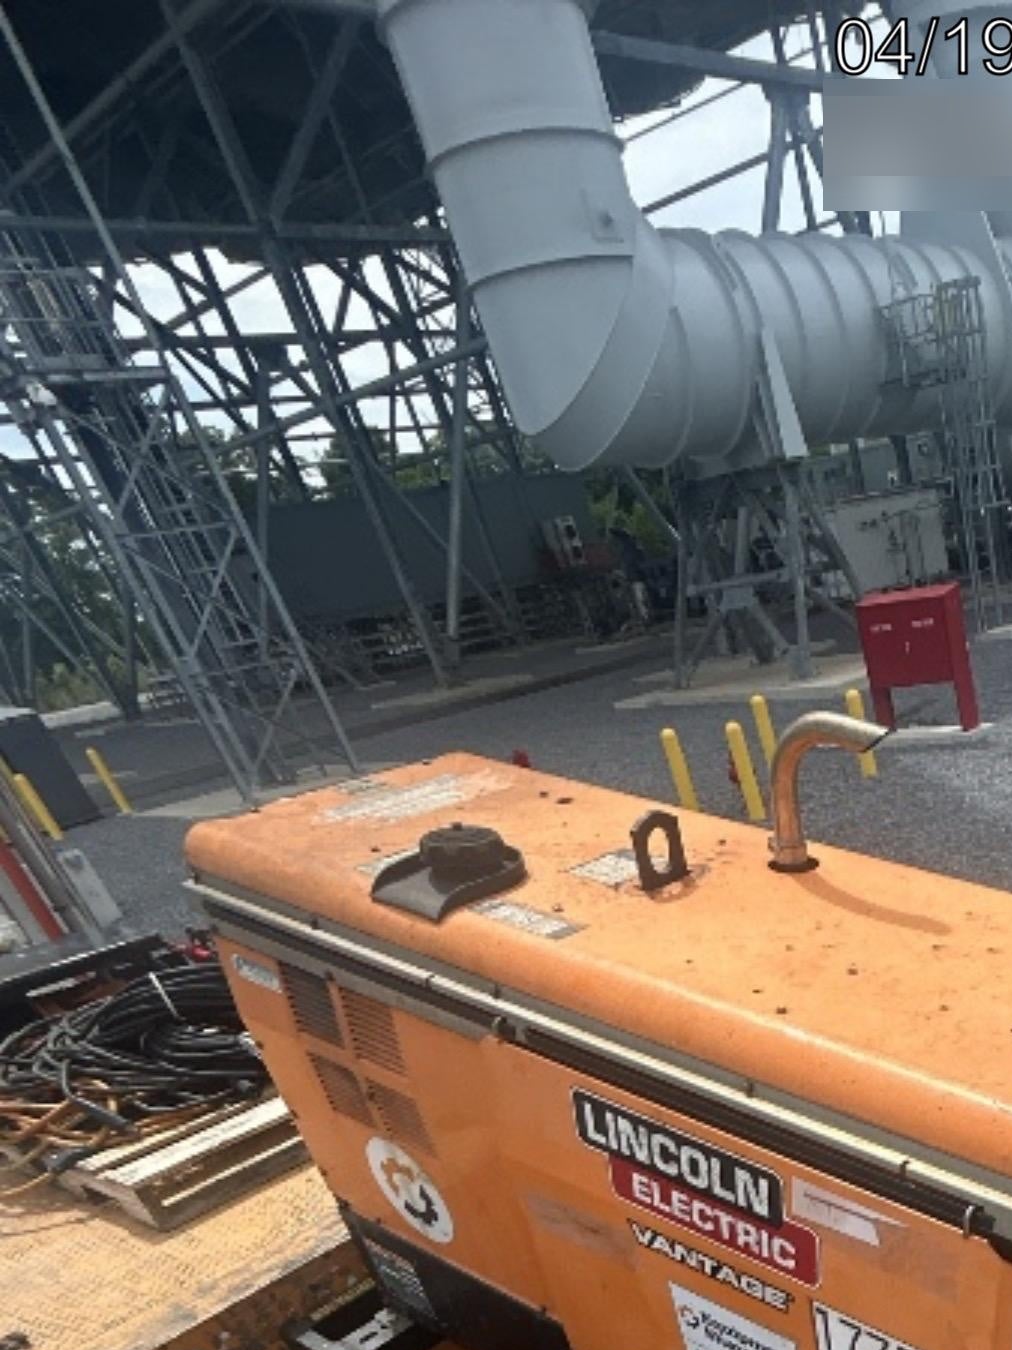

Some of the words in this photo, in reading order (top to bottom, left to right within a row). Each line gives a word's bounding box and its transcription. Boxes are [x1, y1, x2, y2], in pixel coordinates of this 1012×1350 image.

[583, 1101, 770, 1219] LINCOLN
[628, 1220, 791, 1309] VANTAGE
[631, 1171, 797, 1271] ELECTRIC
